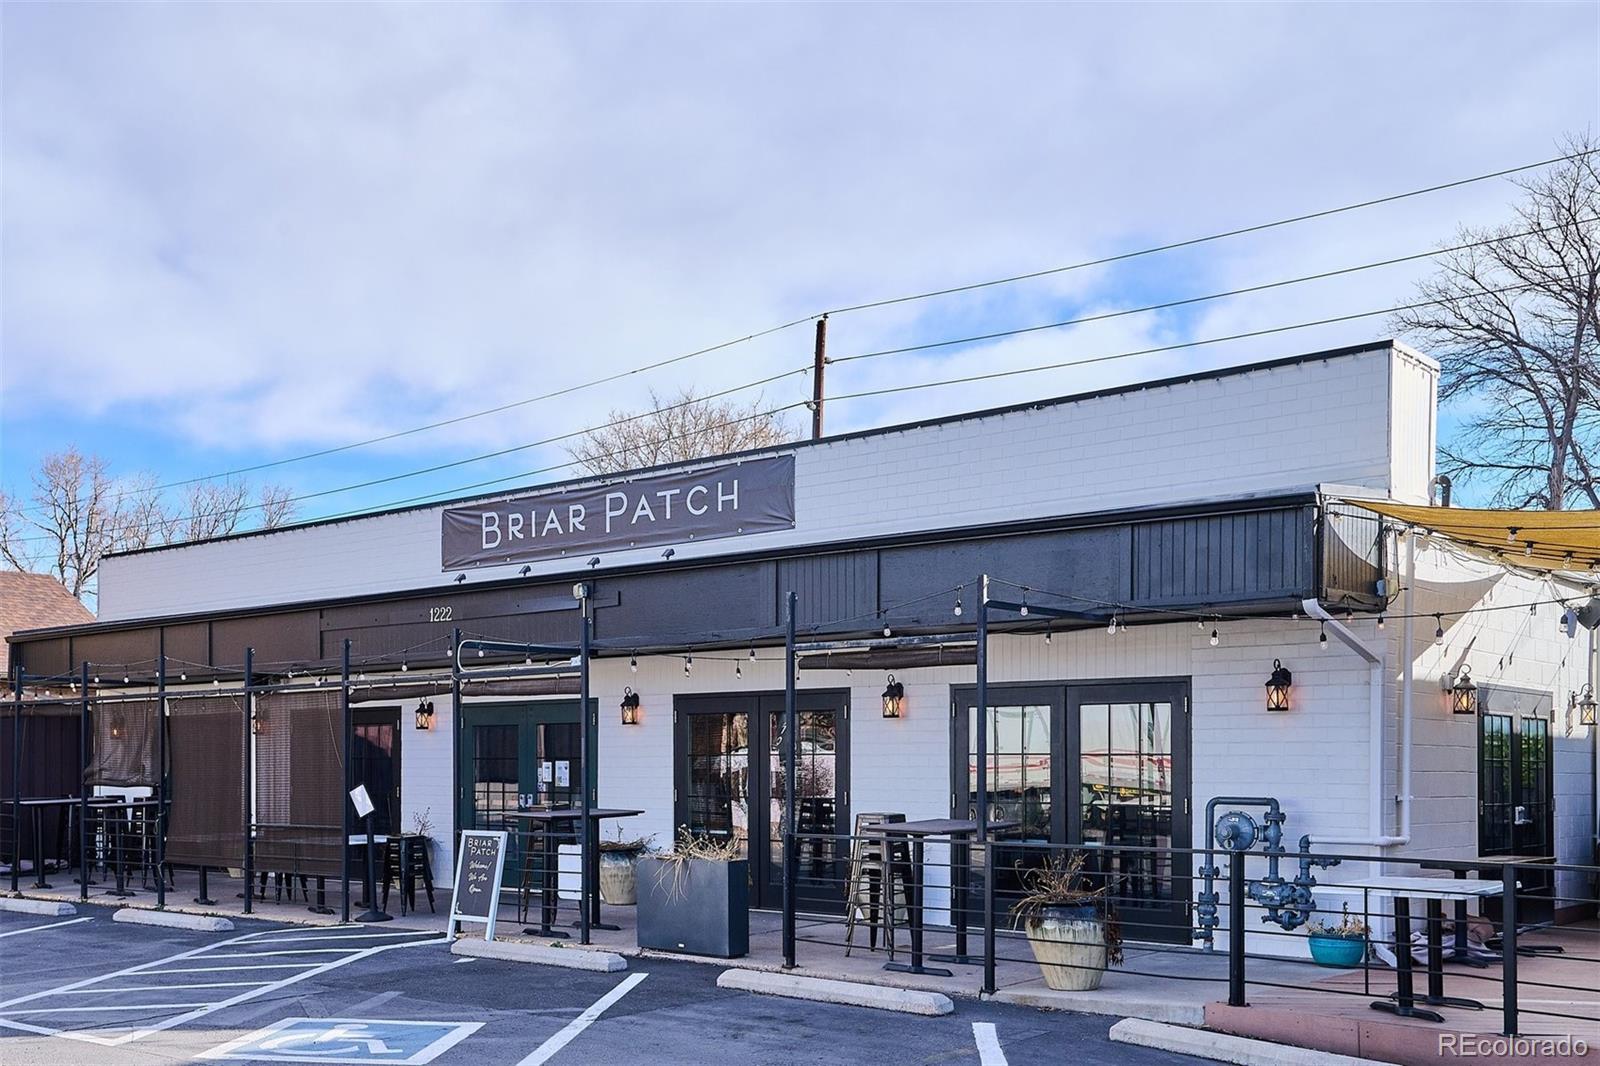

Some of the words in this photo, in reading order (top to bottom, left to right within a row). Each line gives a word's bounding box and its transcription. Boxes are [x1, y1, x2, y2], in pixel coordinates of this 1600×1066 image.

[481, 504, 586, 549] BRIAR
[605, 479, 739, 533] PATCH
[429, 606, 453, 623] 1222
[468, 837, 492, 848] BRIAR
[470, 846, 496, 856] PATCH
